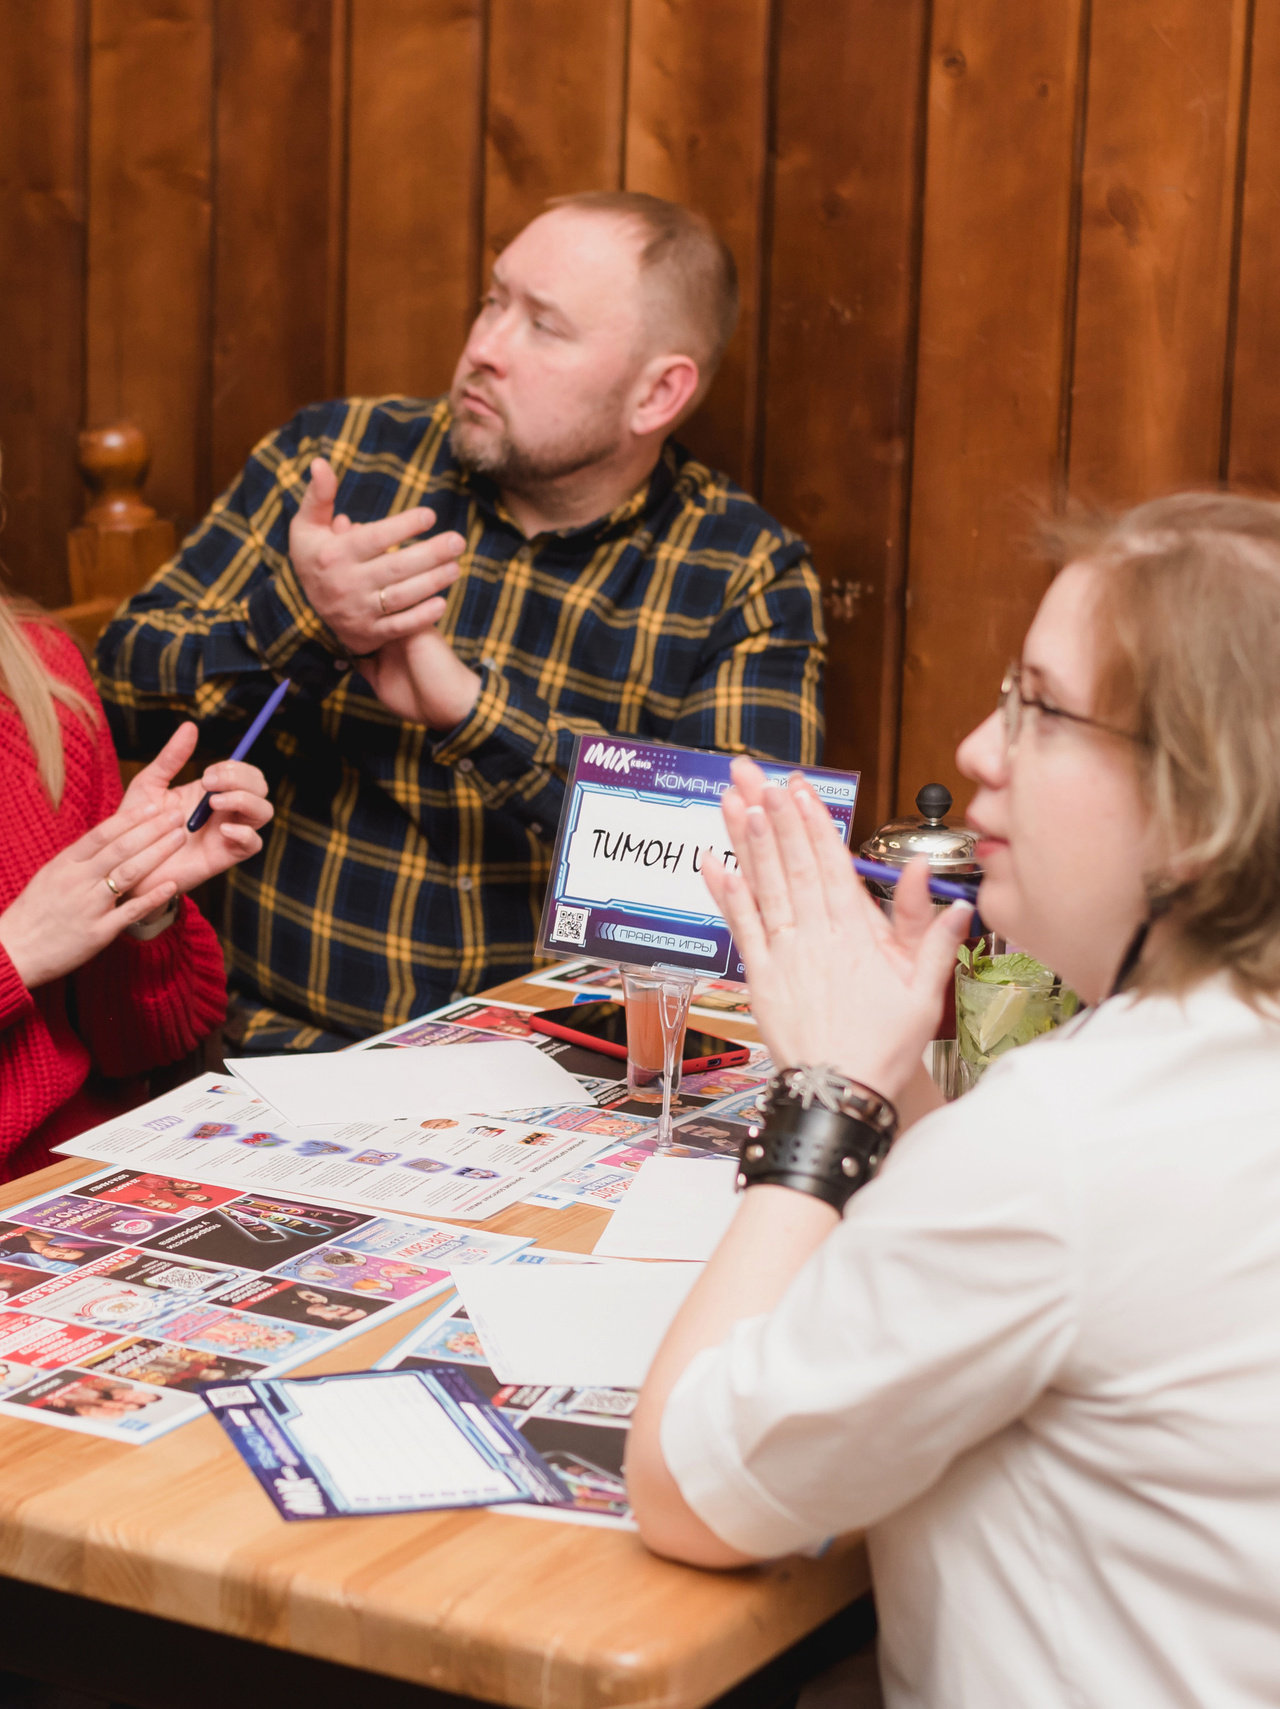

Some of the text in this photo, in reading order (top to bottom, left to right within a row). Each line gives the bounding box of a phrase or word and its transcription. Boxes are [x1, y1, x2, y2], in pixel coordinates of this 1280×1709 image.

[654, 772, 736, 797] КОМАНД
[593, 829, 684, 873] ТИМОН
[620, 929, 713, 953] ПРАВИЛА ИГРЫ
[55, 1200, 100, 1218] РЕТРО
[157, 1224, 204, 1245] персонала
[166, 1223, 221, 1249] подробности
[19, 1252, 130, 1303] MAXIMILIANS.RU
